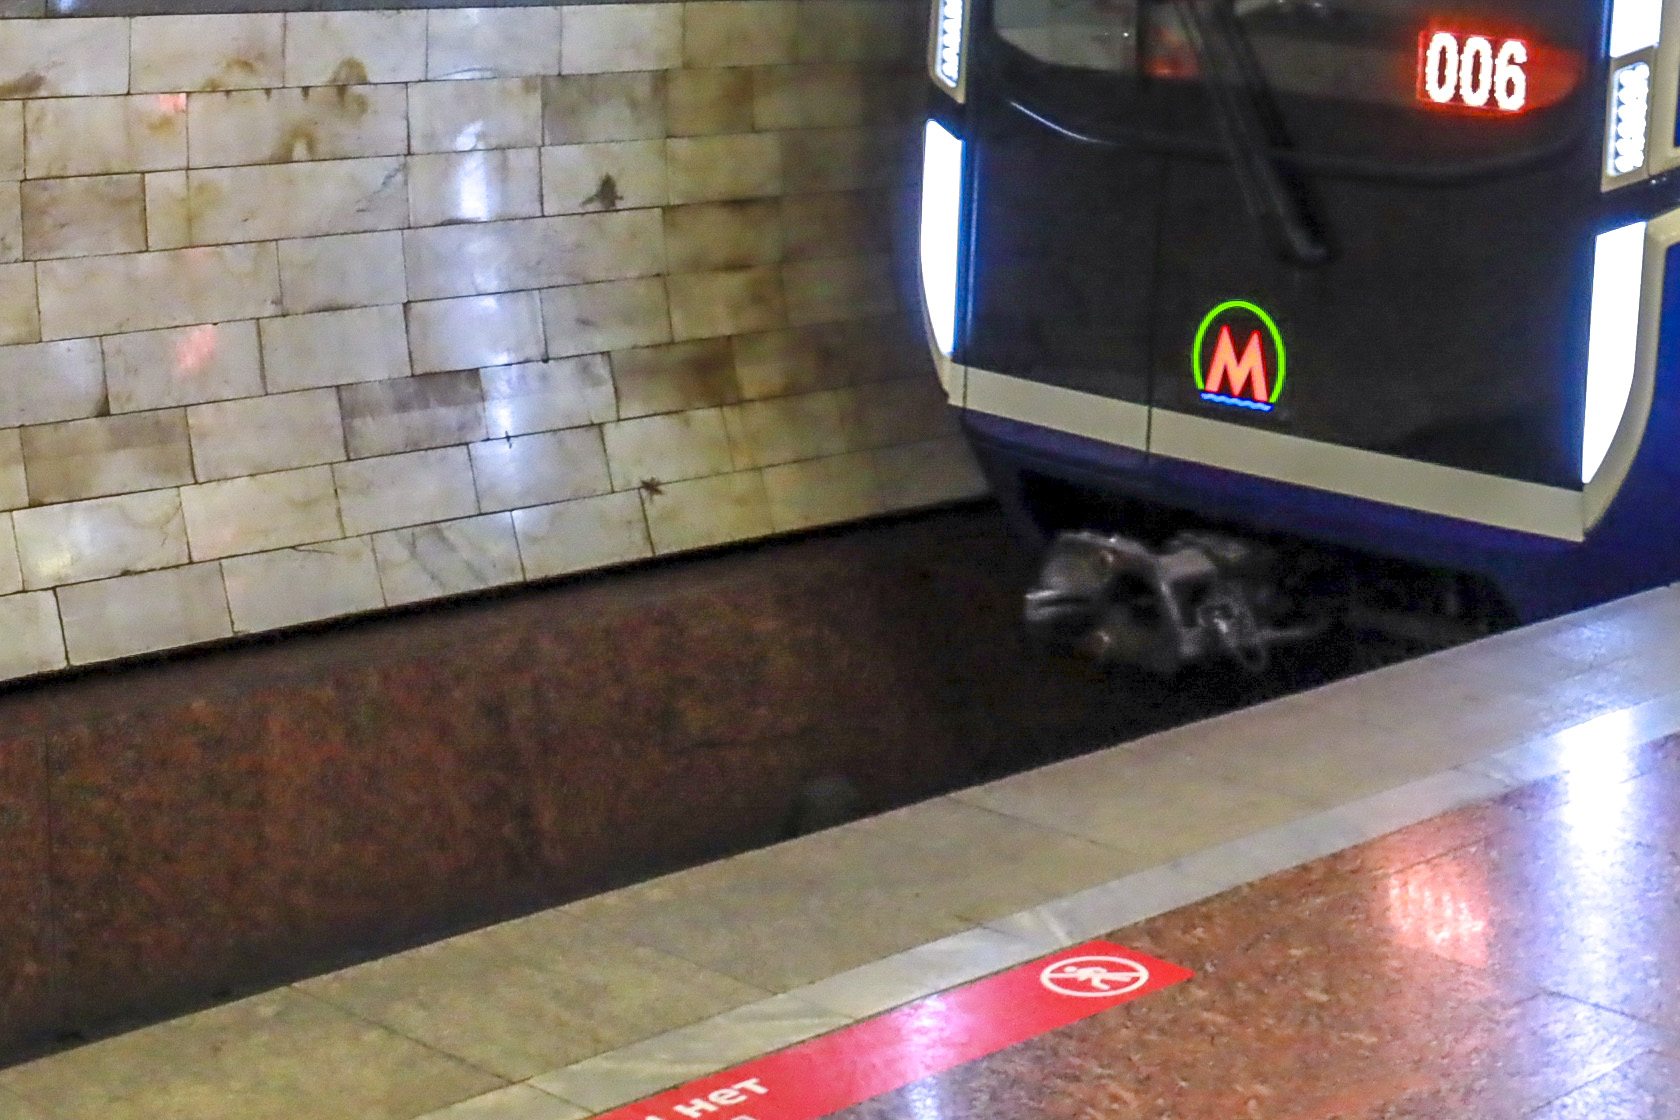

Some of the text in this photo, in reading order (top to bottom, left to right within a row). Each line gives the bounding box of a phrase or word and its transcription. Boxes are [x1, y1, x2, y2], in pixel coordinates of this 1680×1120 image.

[1425, 31, 1528, 111] 006
[1205, 324, 1269, 403] М
[673, 1077, 769, 1119] нет
